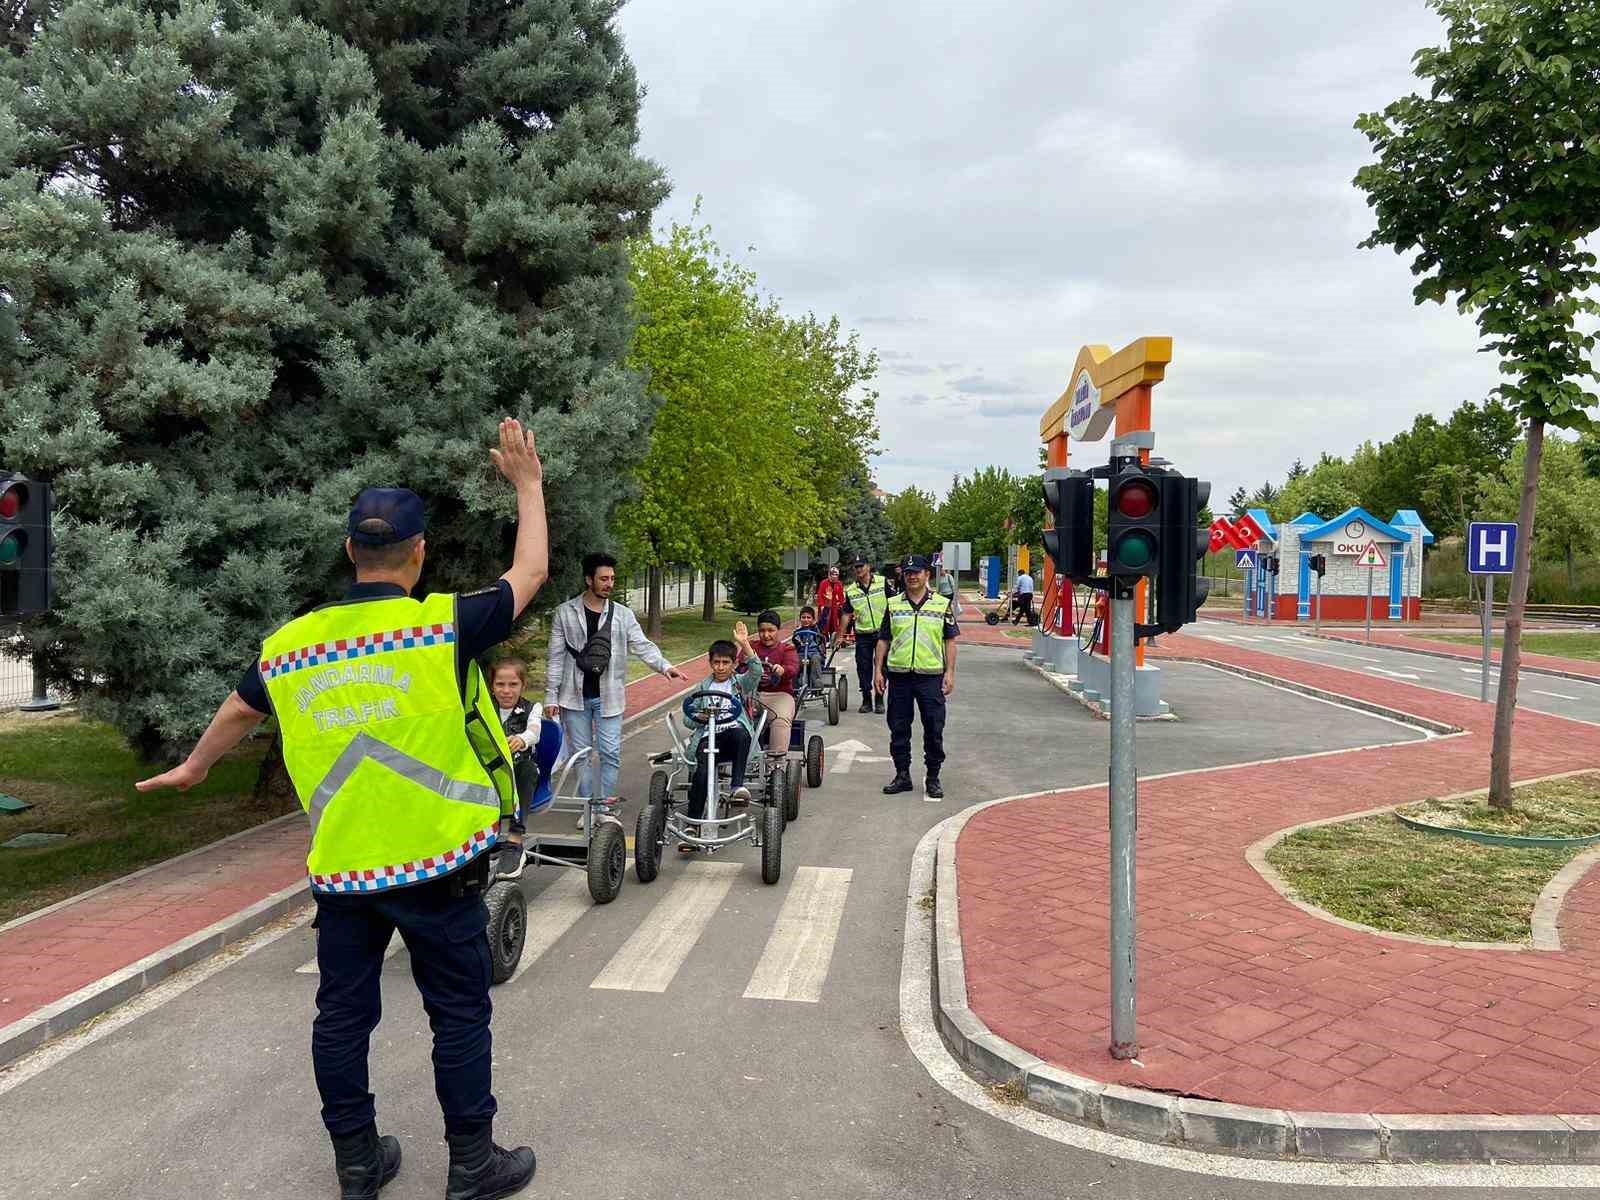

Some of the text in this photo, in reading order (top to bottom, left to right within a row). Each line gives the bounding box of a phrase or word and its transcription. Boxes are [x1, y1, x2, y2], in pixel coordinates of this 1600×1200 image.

[1337, 543, 1366, 552] OKU
[1480, 530, 1507, 566] H
[295, 664, 411, 713] JANDARMA
